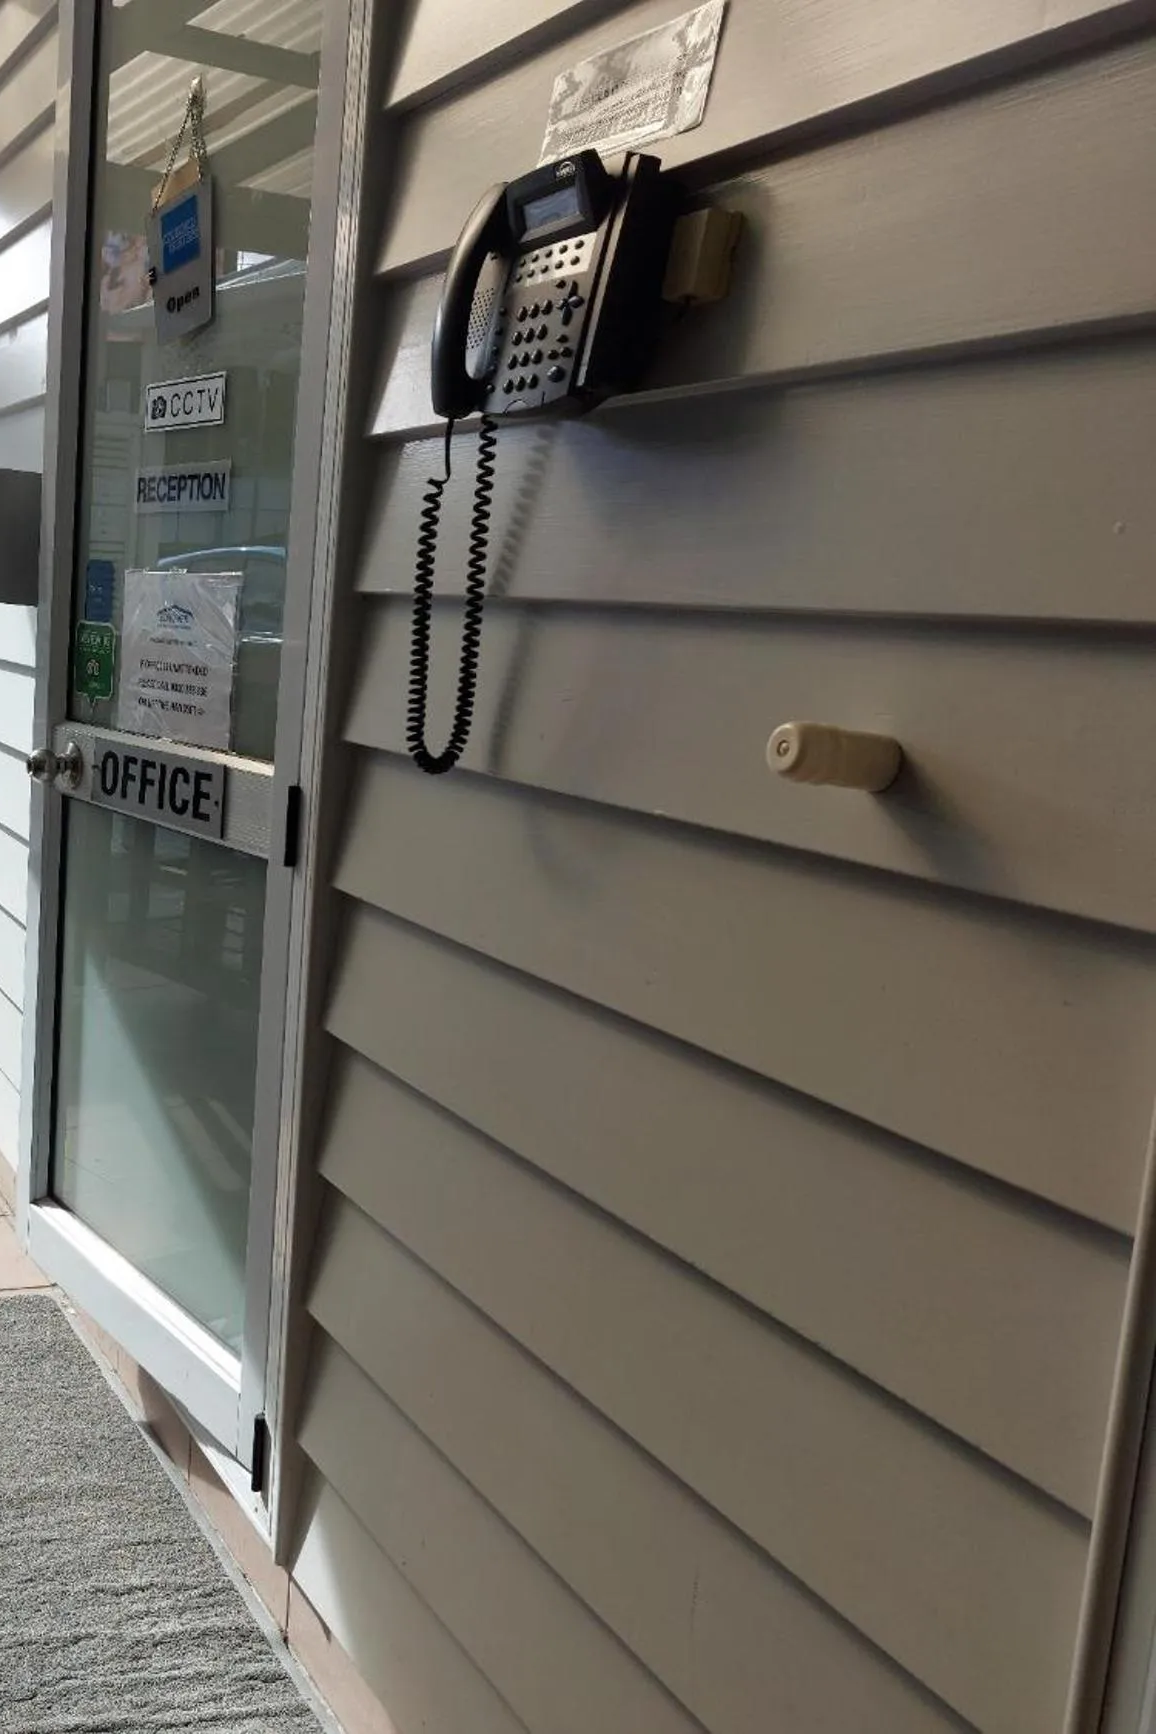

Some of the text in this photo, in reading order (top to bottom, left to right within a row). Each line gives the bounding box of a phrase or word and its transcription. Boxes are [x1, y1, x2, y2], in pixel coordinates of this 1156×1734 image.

[165, 284, 200, 314] Open
[170, 387, 219, 418] CCTV
[136, 472, 227, 503] RECEPTION
[100, 750, 213, 823] OFFICE
